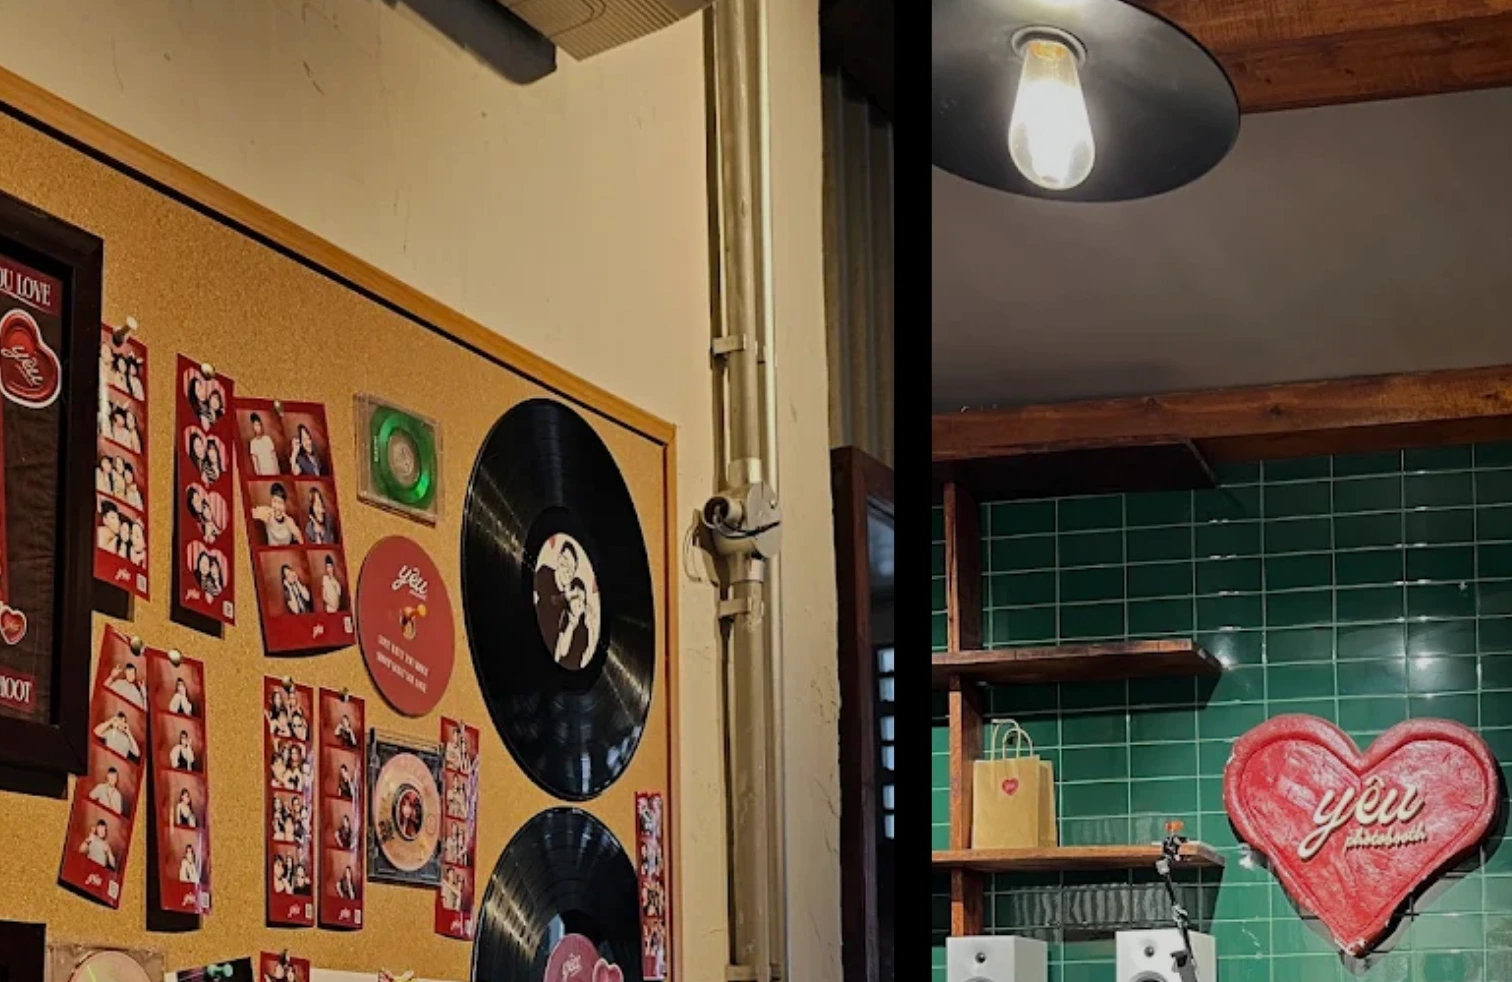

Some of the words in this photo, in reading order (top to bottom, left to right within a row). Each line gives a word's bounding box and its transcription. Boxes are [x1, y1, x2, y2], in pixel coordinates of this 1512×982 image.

[16, 276, 51, 306] LOVE
[0, 345, 44, 386] yêu
[392, 565, 429, 595] yêu
[1297, 775, 1425, 861] yêu
[1342, 821, 1428, 853] photobooth
